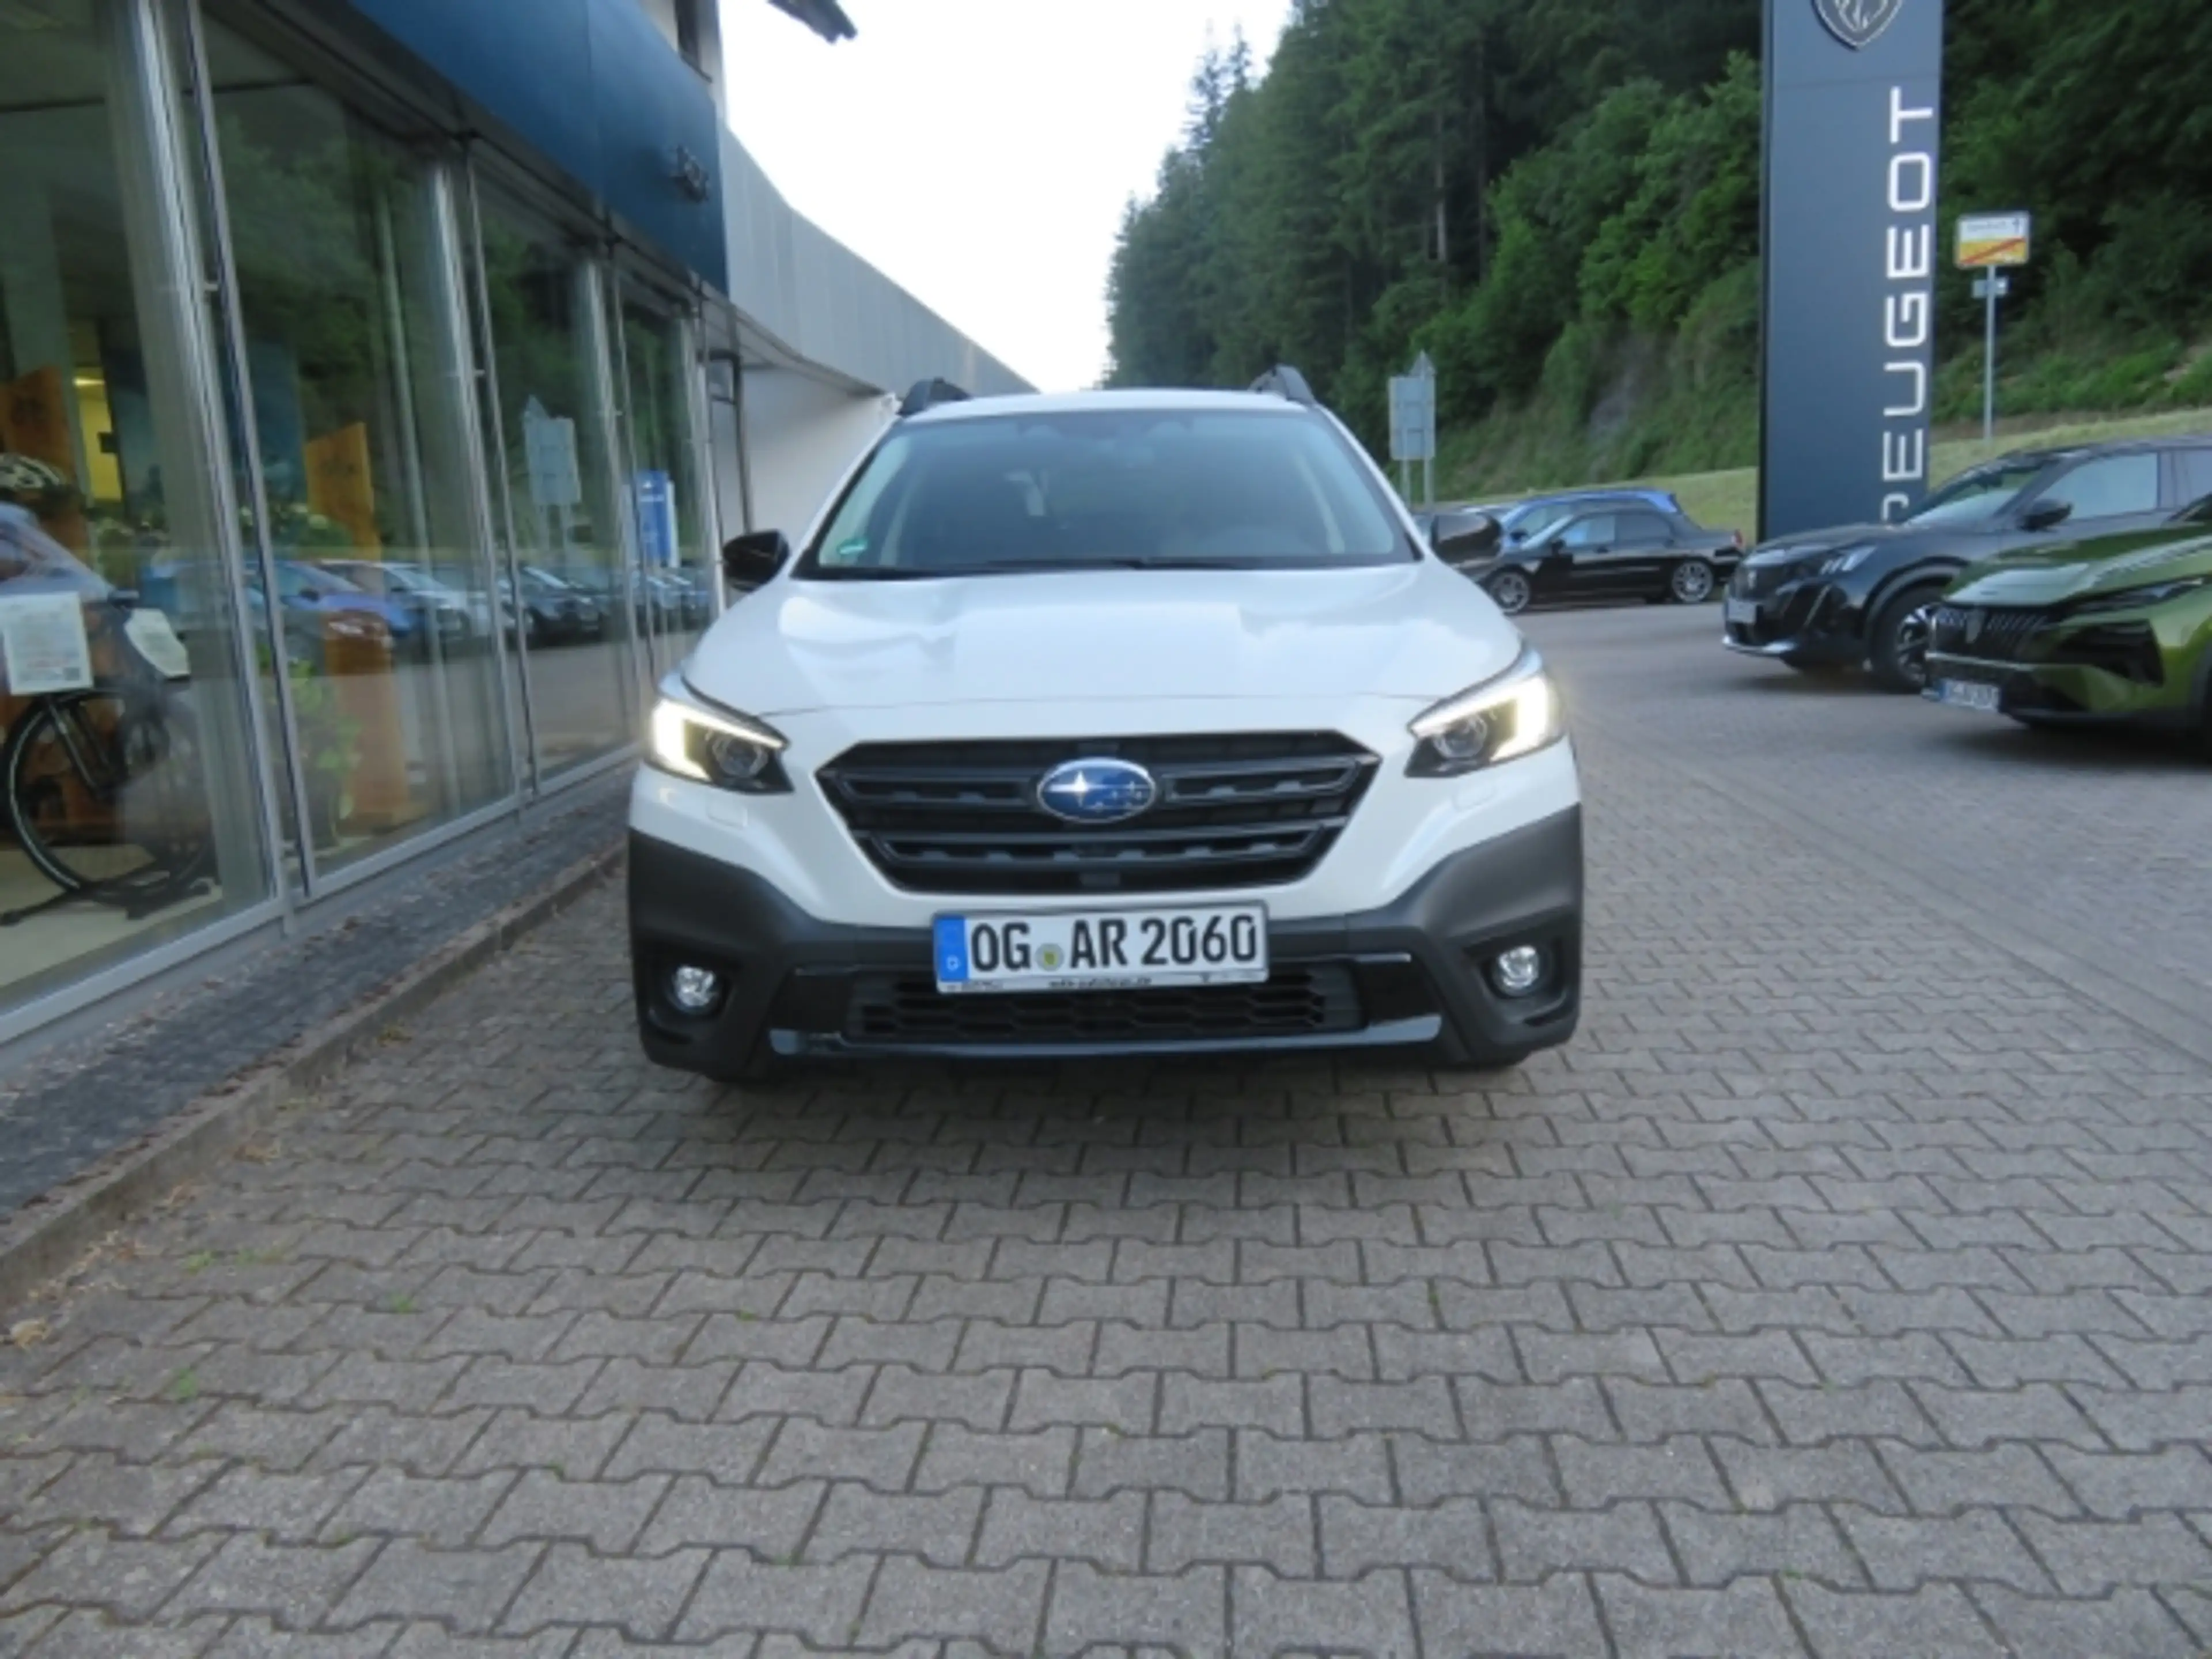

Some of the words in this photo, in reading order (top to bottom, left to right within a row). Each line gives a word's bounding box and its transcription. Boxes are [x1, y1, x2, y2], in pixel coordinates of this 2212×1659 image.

[971, 922, 1032, 972] OG
[1070, 918, 1128, 968] AR
[1140, 914, 1257, 966] 2060
